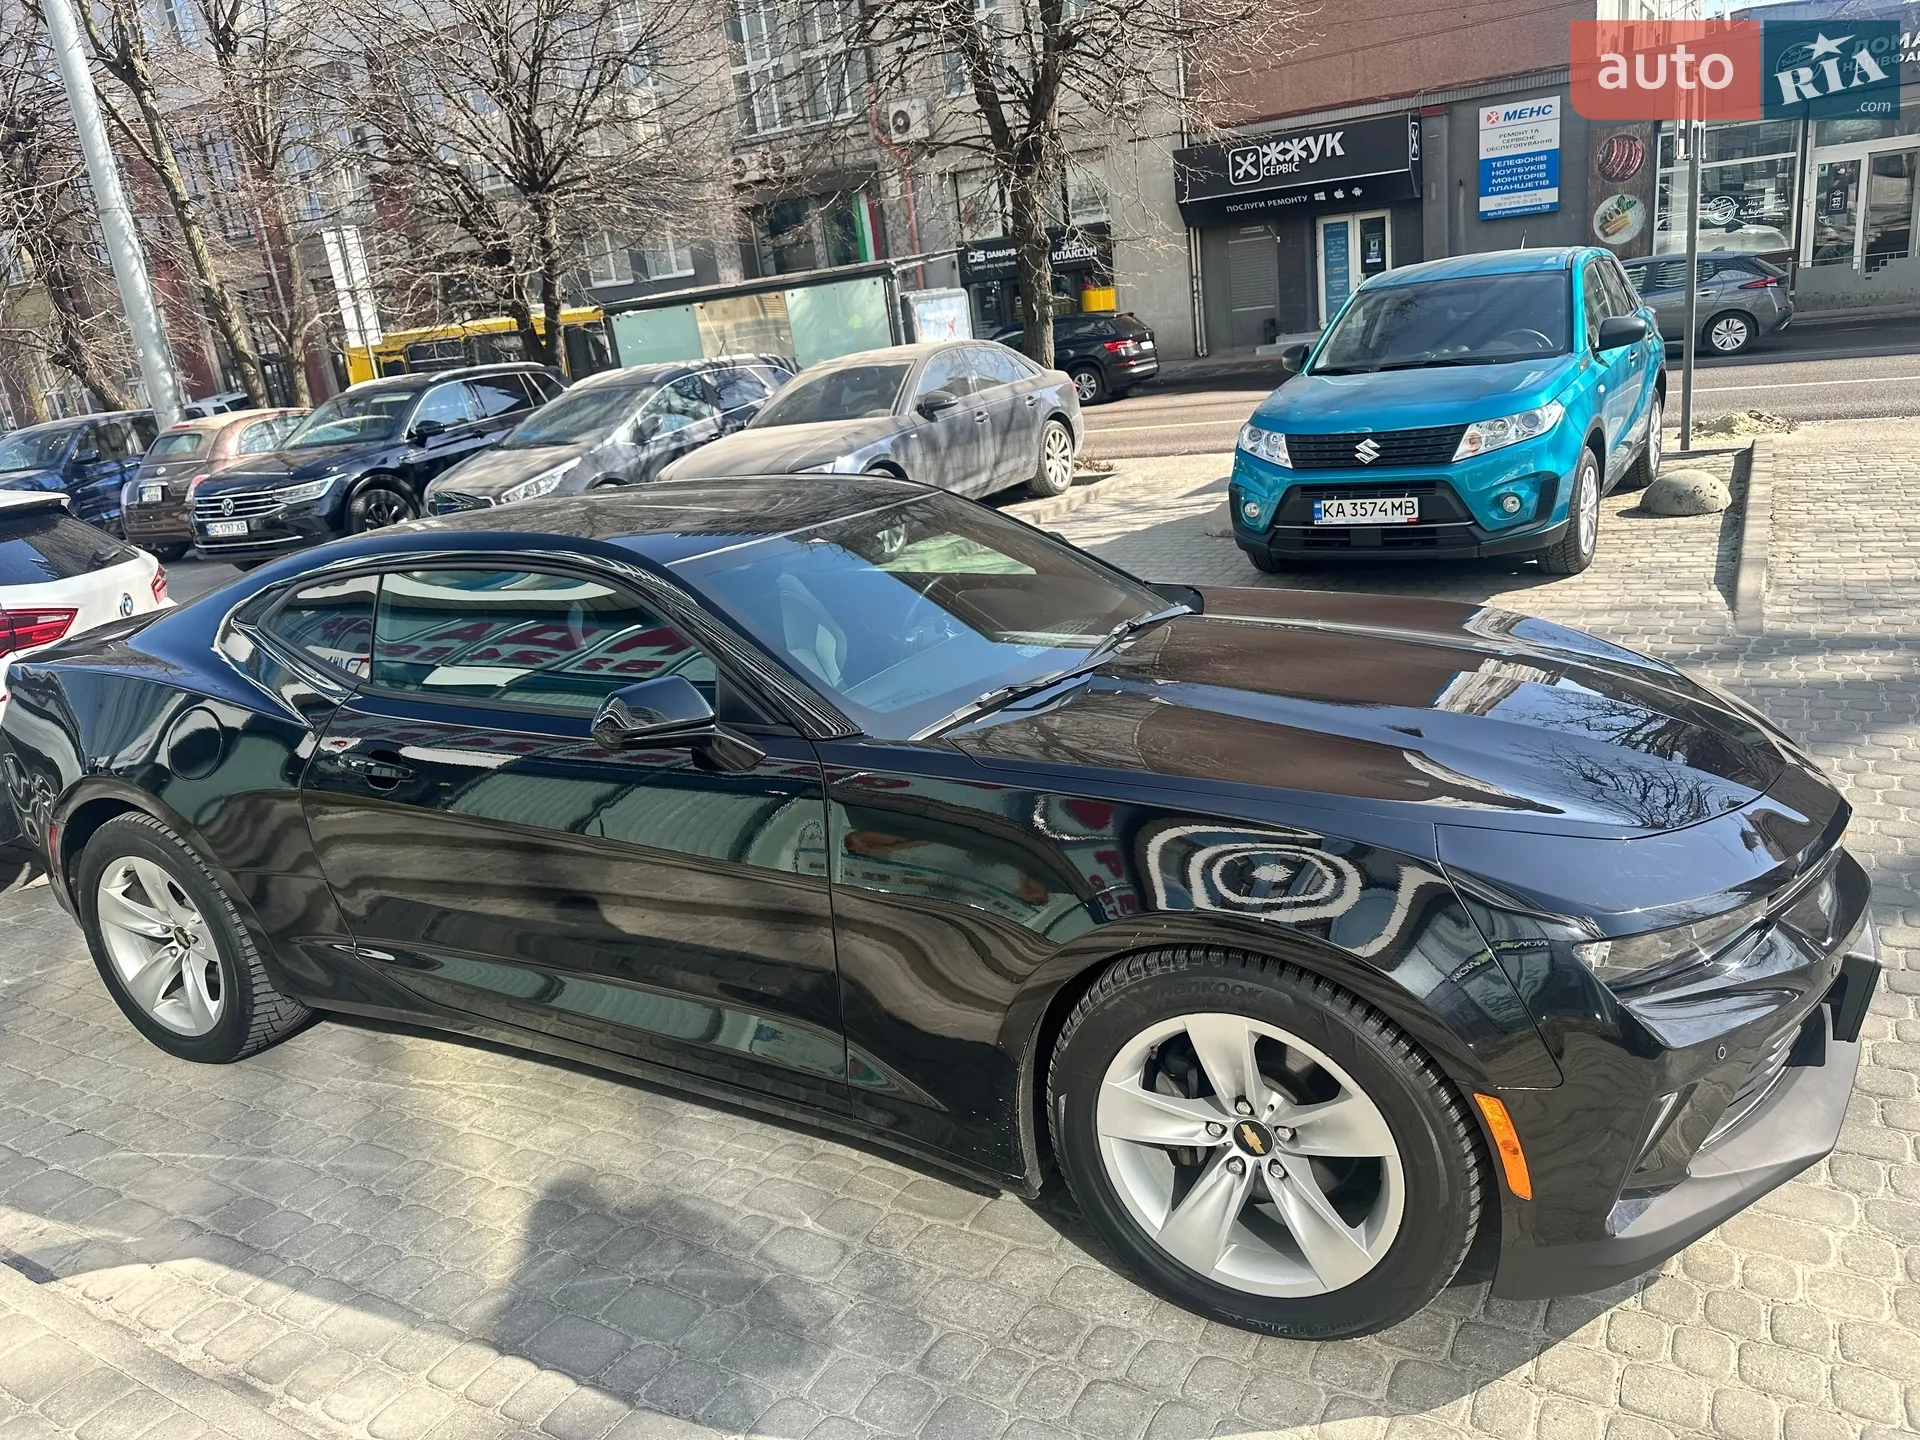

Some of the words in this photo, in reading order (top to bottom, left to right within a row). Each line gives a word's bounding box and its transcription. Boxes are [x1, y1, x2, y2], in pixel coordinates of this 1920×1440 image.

[1503, 104, 1553, 122] МЕНС
[1498, 129, 1528, 139] РЕМОНТ
[1502, 135, 1536, 144] СЕРВІСНЕ
[1486, 138, 1553, 152] ОБСЛУГОВУВАННЯ
[1491, 154, 1548, 168] ТЕЛЕФОНІВ
[1263, 161, 1300, 177] СЕРВІС
[1491, 163, 1547, 177] НОУТБУКІВ
[1491, 172, 1547, 185] МОНІТОРІВ
[1488, 179, 1550, 193] ПЛАНШЕТІВ
[1226, 201, 1265, 213] ПОСЛУГИ
[1267, 195, 1308, 207] РЕМОНТУ
[967, 250, 986, 264] DS
[1051, 246, 1098, 261] КЛАКСОН
[1323, 503, 1346, 518] KA
[1350, 501, 1388, 517] 3574
[1391, 500, 1416, 516] MB
[209, 523, 219, 534] BC
[220, 523, 234, 533] 1797
[236, 522, 246, 532] XB
